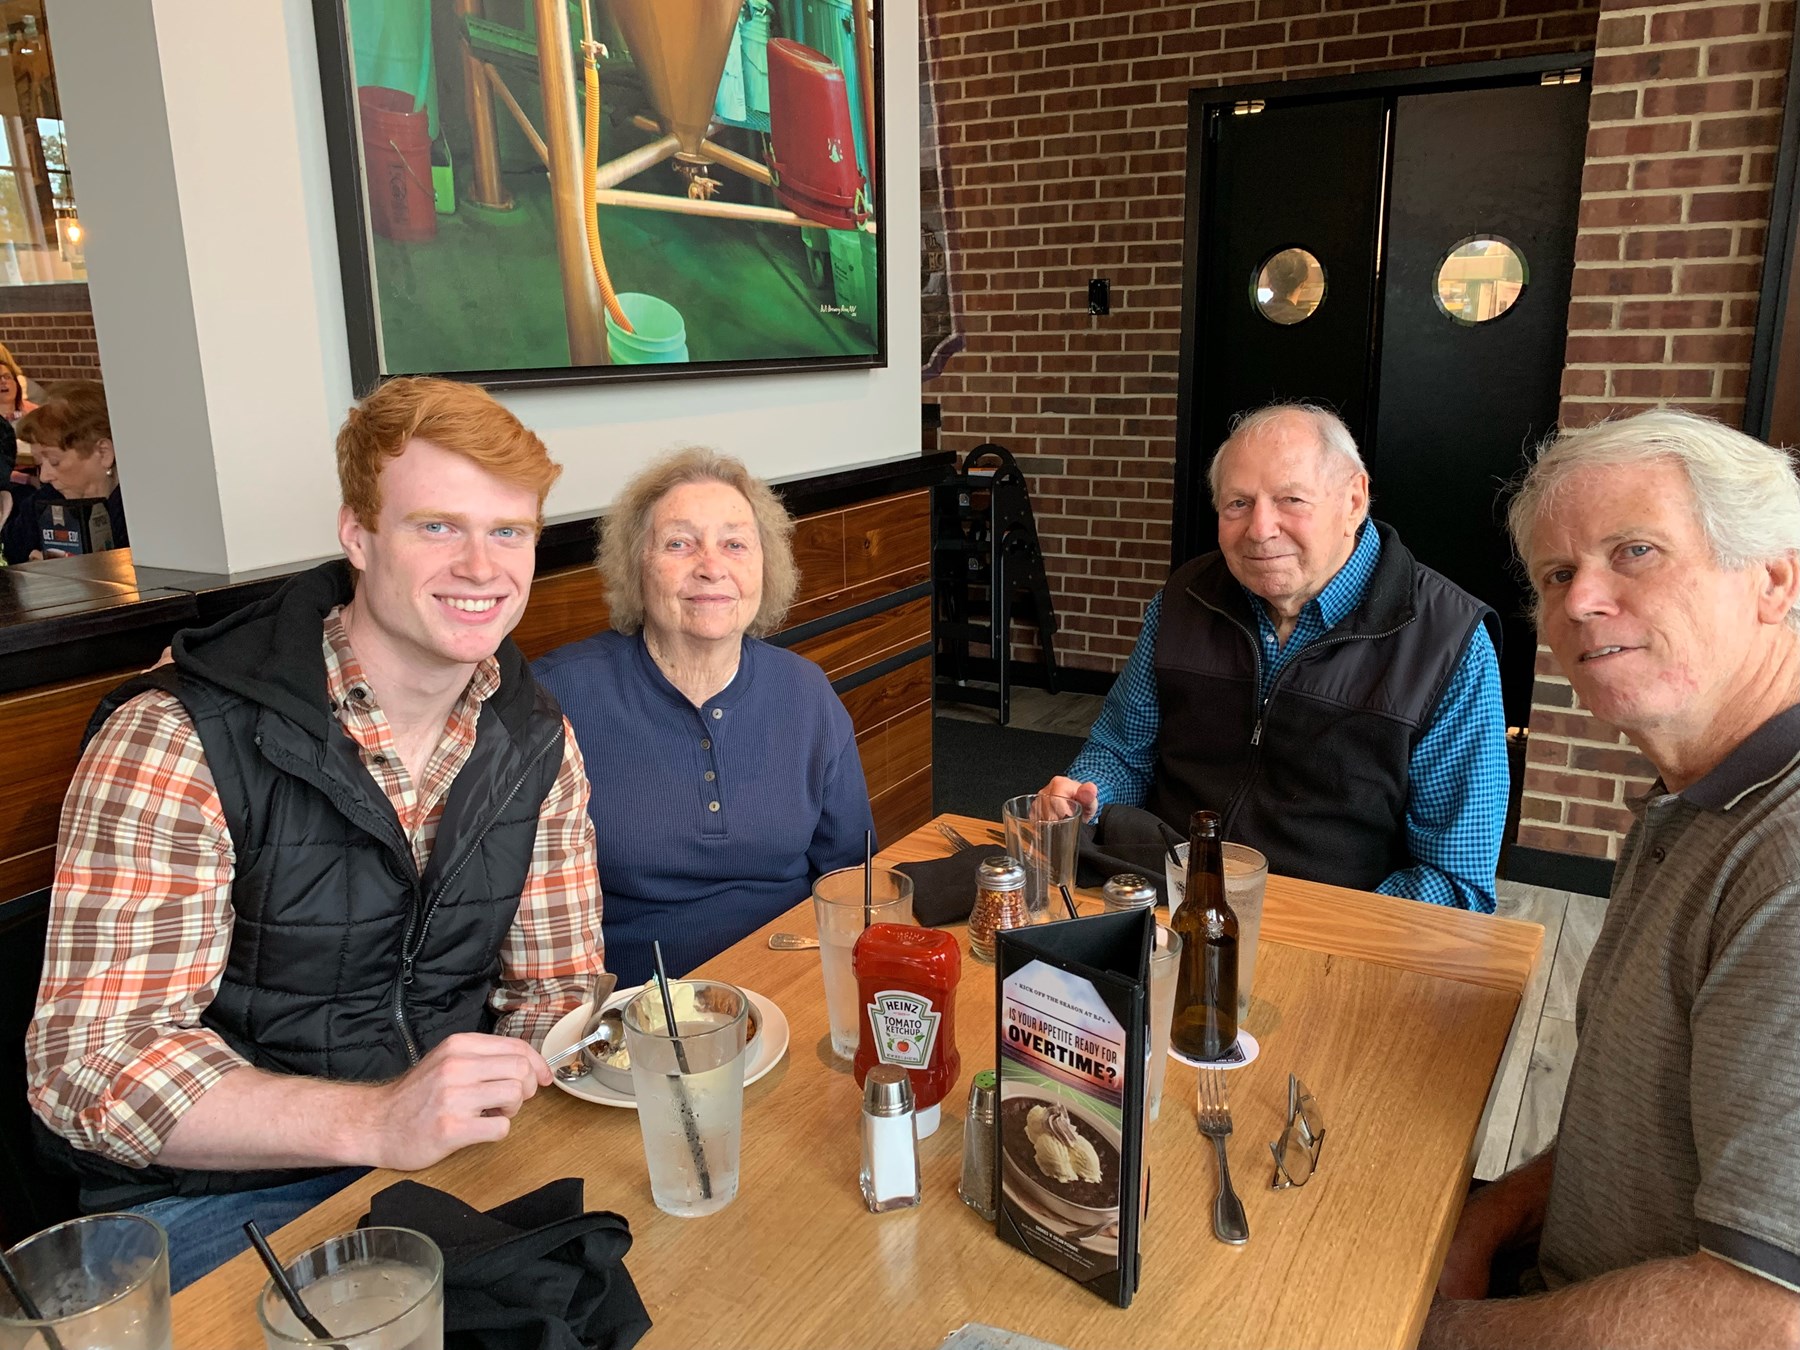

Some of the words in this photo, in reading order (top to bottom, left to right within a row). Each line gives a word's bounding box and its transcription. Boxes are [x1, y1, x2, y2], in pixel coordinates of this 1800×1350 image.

[886, 1001, 919, 1014] HEINZ
[1019, 983, 1033, 994] KICK
[1034, 989, 1045, 998] OFF
[1046, 994, 1058, 1004] THE
[1060, 999, 1083, 1014] SEASON
[884, 1016, 922, 1029] TOMATO
[886, 1025, 921, 1036] KETCHUP
[1009, 1007, 1017, 1021] IS
[1017, 1011, 1037, 1031] YOUR
[1038, 1020, 1073, 1046] APPETITE
[1075, 1036, 1100, 1057] READY
[1101, 1047, 1117, 1064] FOR
[1009, 1024, 1117, 1083] OVERTIME?
